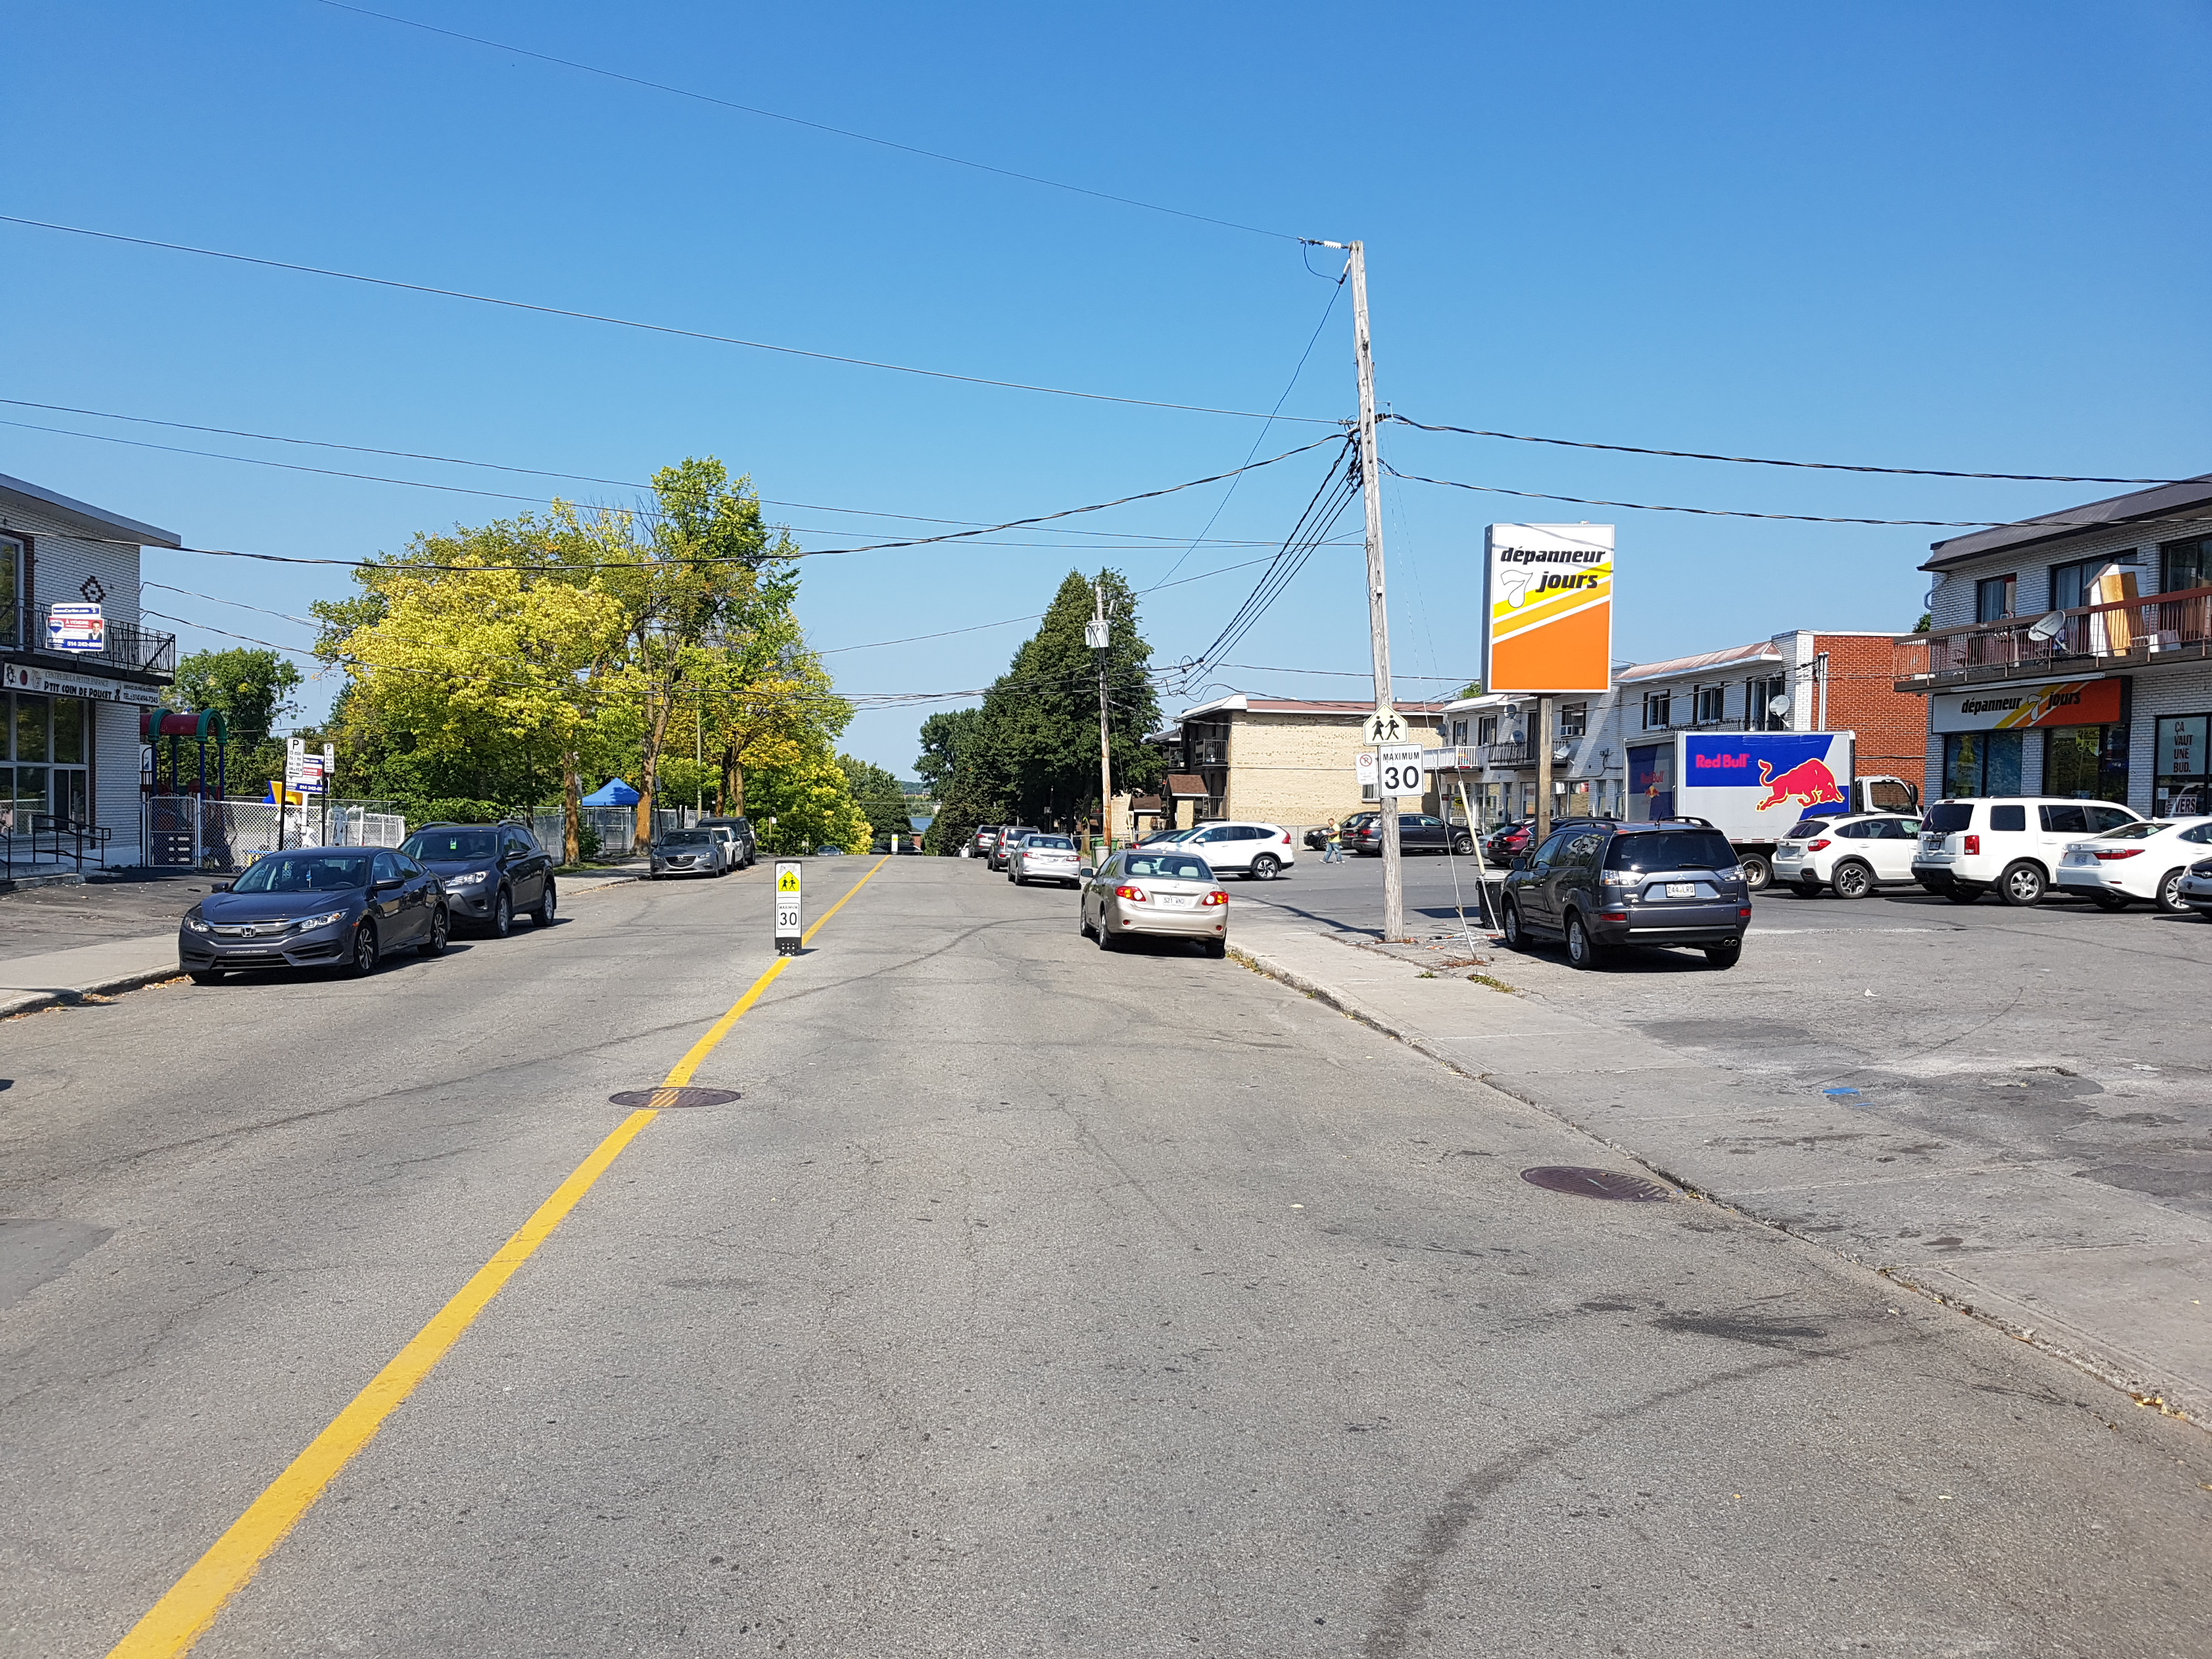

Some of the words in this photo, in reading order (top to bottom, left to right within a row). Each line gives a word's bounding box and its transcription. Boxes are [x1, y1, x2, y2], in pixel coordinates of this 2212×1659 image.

[1500, 545, 1606, 565] dépanneur
[1500, 569, 1533, 608] 7
[1535, 571, 1598, 593] jours
[61, 684, 78, 695] COIN
[78, 687, 88, 697] DE
[88, 687, 112, 700] POUCET
[1961, 697, 2023, 716] dépanneur
[2026, 693, 2043, 722] 7
[2045, 690, 2081, 710] jours
[2174, 721, 2185, 735] ÇA
[292, 739, 300, 750] P
[2174, 734, 2194, 747] VAUT
[326, 744, 331, 753] P
[2174, 748, 2189, 760] UNE
[1383, 751, 1419, 761] MAXIMUM
[1695, 753, 1721, 768] Red
[1722, 753, 1748, 768] Bull
[2173, 761, 2191, 773] BUD.
[1385, 765, 1419, 790] 30
[1641, 772, 1652, 784] Red
[1652, 770, 1664, 783] Bull
[2174, 798, 2196, 813] VERS
[780, 912, 797, 926] 30
